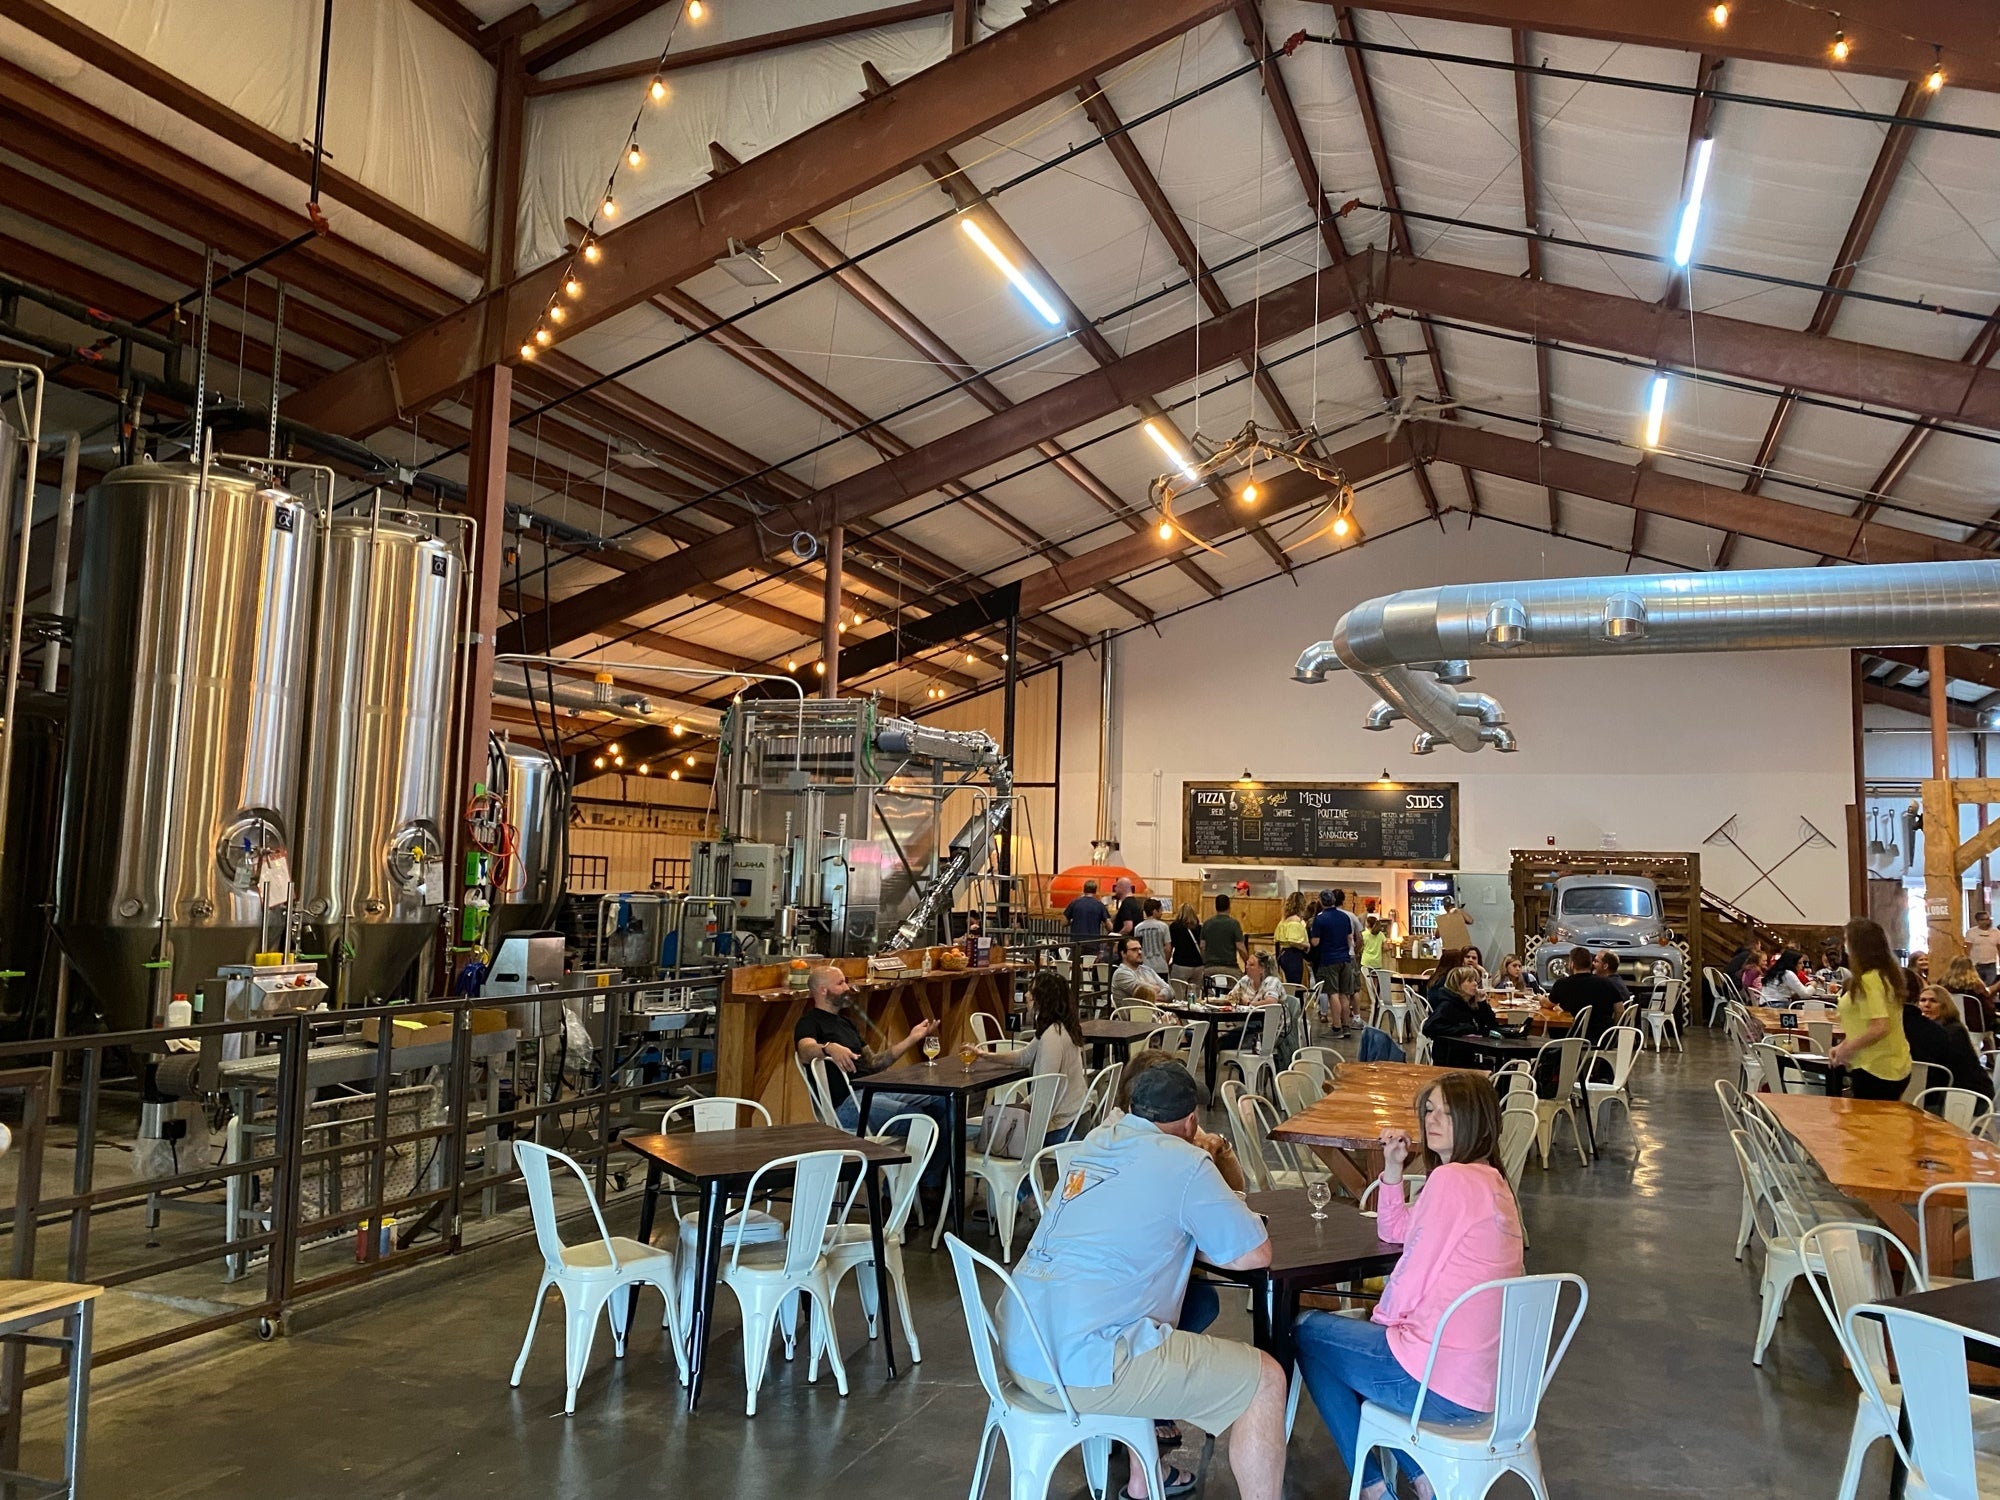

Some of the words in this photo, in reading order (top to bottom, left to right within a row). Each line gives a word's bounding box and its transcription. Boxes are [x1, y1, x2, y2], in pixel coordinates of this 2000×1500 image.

[1197, 792, 1226, 805] PIZZA
[1299, 791, 1331, 808] MENU
[1405, 794, 1444, 809] SIDES
[1211, 808, 1224, 816] RED
[1276, 809, 1293, 817] WHITE
[1318, 830, 1359, 841] SANDWICHES
[733, 861, 765, 869] ALPHA
[1926, 905, 1950, 916] LODGE
[1009, 1016, 1016, 1029] 7
[1782, 1015, 1796, 1027] 64
